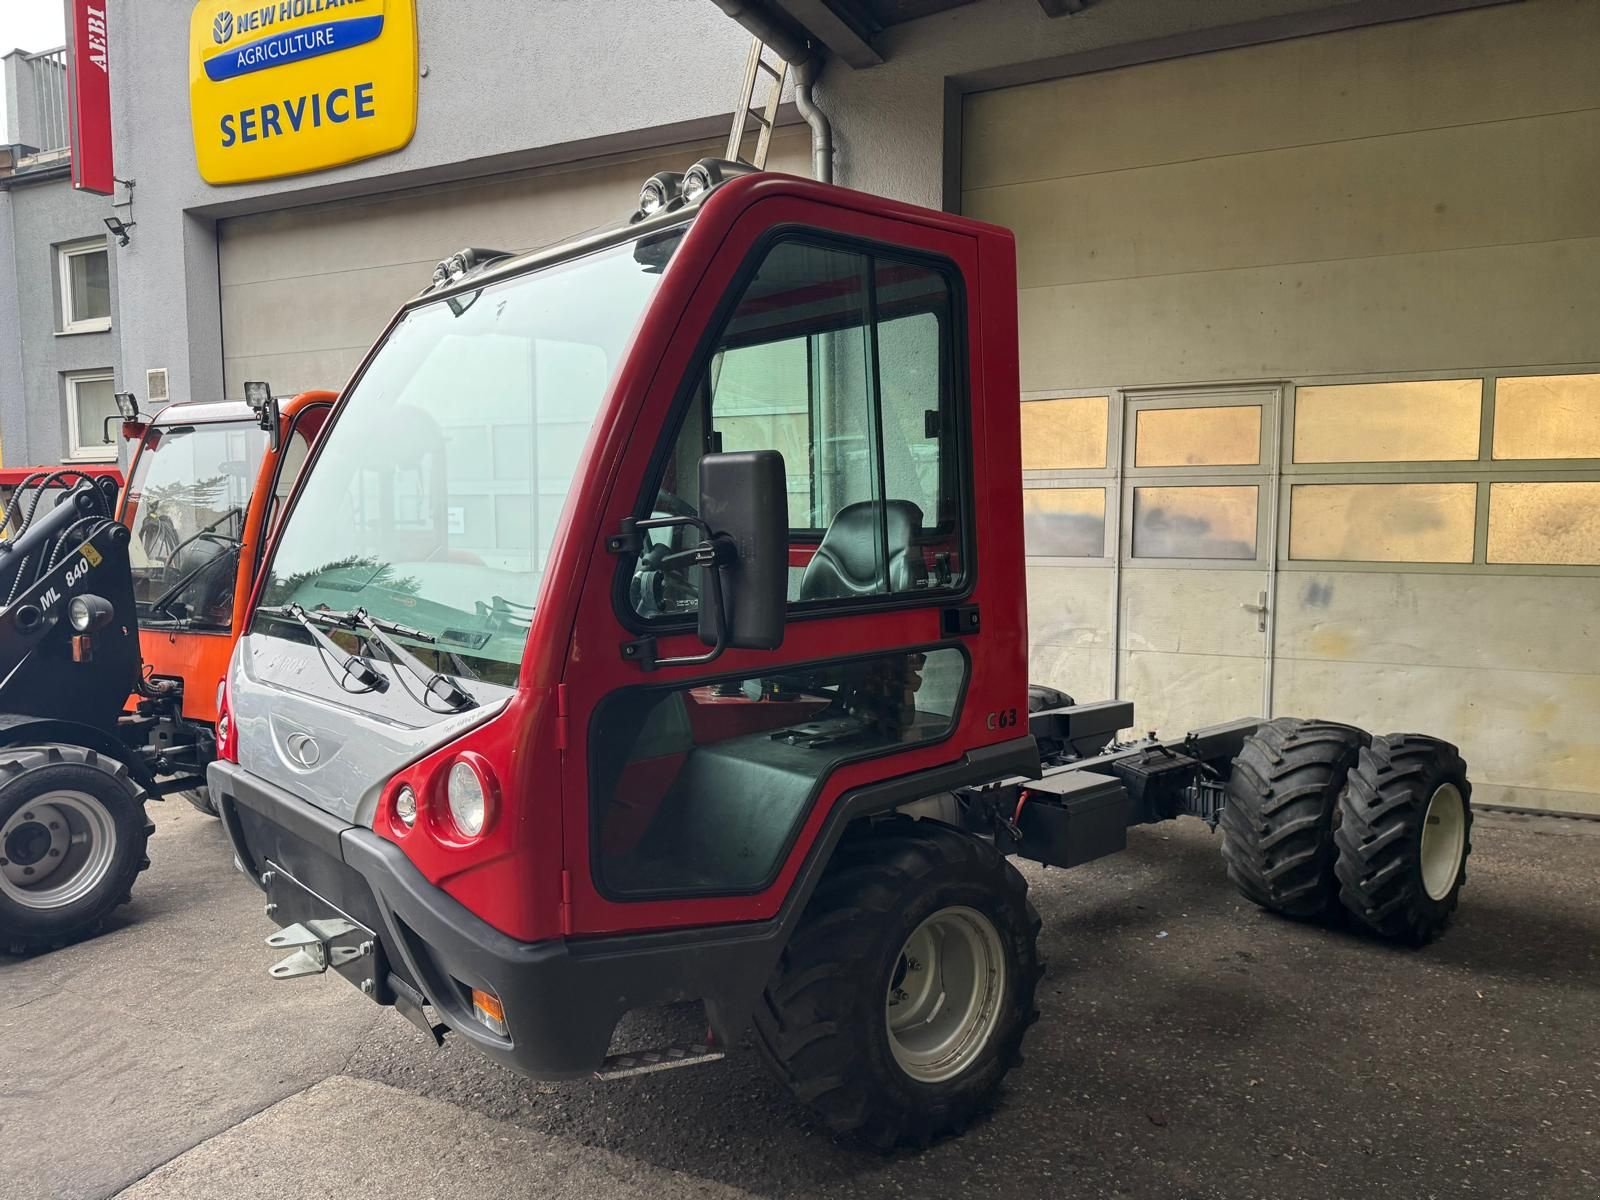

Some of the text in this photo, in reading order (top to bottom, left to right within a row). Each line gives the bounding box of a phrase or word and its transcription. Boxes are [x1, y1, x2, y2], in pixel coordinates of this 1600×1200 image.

[87, 5, 107, 73] AEBI
[236, 0, 366, 34] NEW HOLL
[236, 27, 335, 68] AGRICULTURE
[220, 82, 376, 148] SERVICE
[40, 557, 89, 611] ML 840
